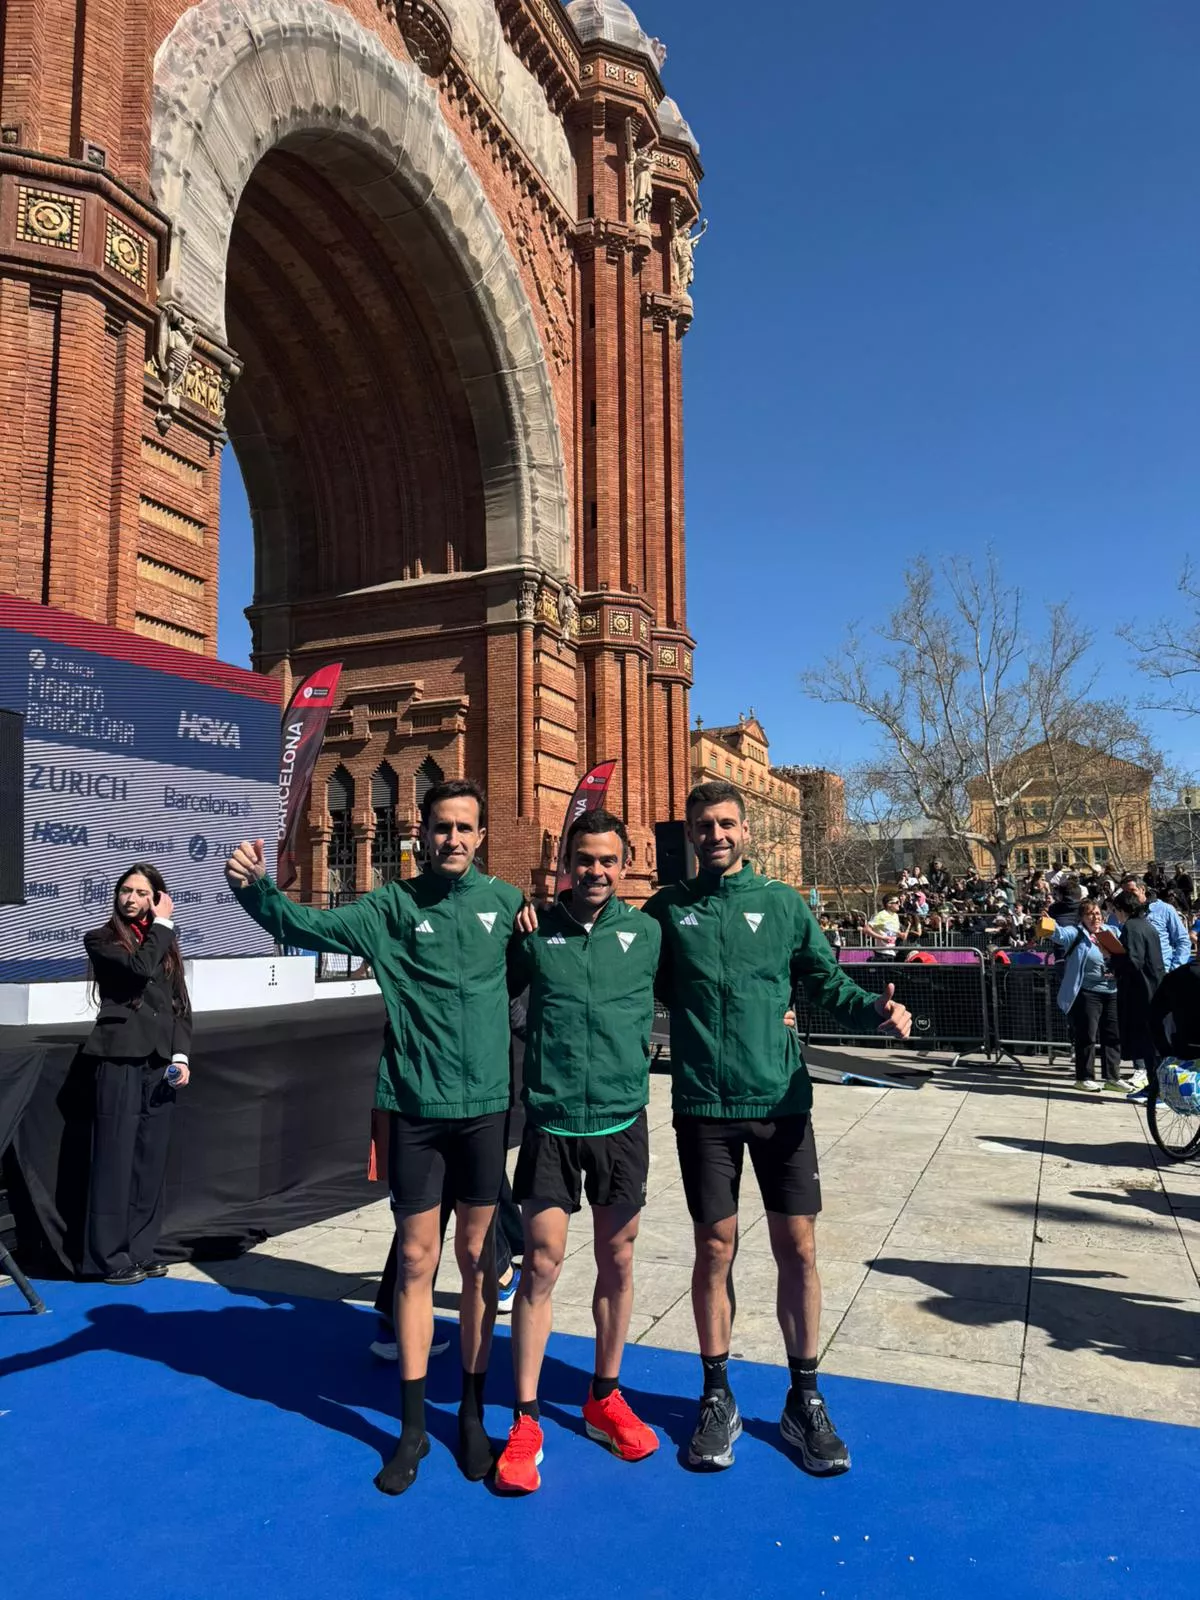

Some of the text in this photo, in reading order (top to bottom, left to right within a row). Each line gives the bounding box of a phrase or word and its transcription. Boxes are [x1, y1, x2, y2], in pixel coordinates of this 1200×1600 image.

[26, 699, 135, 746] BARCELONA
[177, 710, 241, 749] HOKA
[28, 763, 128, 801] ZURICH
[163, 785, 240, 816] Barcelona
[31, 820, 88, 848] HOKA
[106, 832, 165, 854] Barcelona
[268, 964, 278, 986] 1
[350, 982, 357, 996] 3
